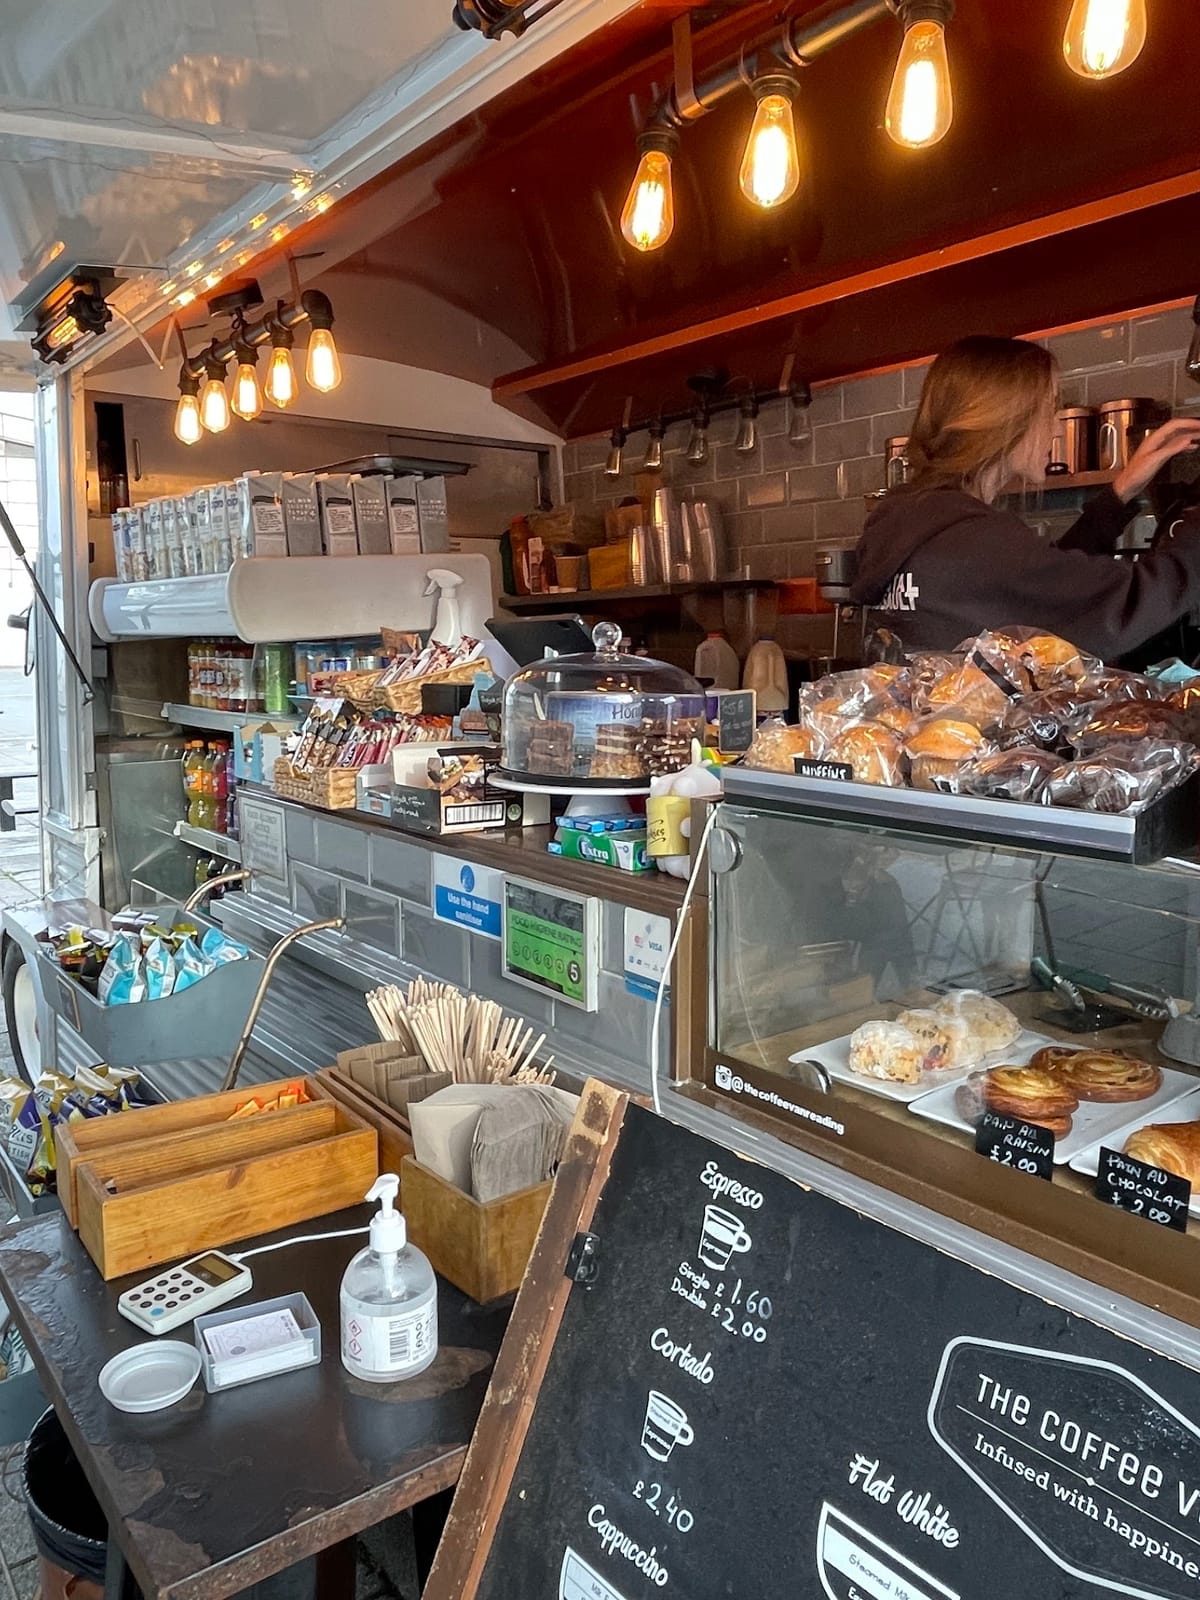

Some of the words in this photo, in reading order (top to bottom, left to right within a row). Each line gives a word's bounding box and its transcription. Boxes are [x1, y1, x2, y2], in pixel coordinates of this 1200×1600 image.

[580, 837, 609, 861] Extra
[447, 893, 460, 906] Use
[461, 896, 472, 909] the
[472, 900, 489, 915] hand
[511, 914, 530, 930] FOOD
[530, 919, 557, 940] HYGIENE
[558, 931, 583, 948] RATING
[648, 941, 663, 952] VISA
[570, 963, 579, 982] 5
[1003, 1133, 1050, 1156] RAISIN
[700, 1161, 764, 1209] Espresso
[1106, 1154, 1142, 1178] PAIN
[1147, 1169, 1168, 1185] AU
[1107, 1172, 1188, 1211] CHOCOLAT
[670, 1276, 707, 1310] Double
[721, 1306, 767, 1343] 2.00
[678, 1261, 711, 1290] Single
[731, 1278, 773, 1320] 1.60
[650, 1327, 714, 1384] Cortado
[645, 1483, 694, 1533] 2.40
[848, 1453, 895, 1504] Flat
[896, 1489, 960, 1549] White
[974, 1433, 1050, 1491] Infused
[1053, 1481, 1100, 1521] with
[1103, 1507, 1200, 1580] happine
[1177, 1480, 1200, 1524] V
[587, 1504, 669, 1587] Cappuccino
[849, 1553, 892, 1591] Steamed
